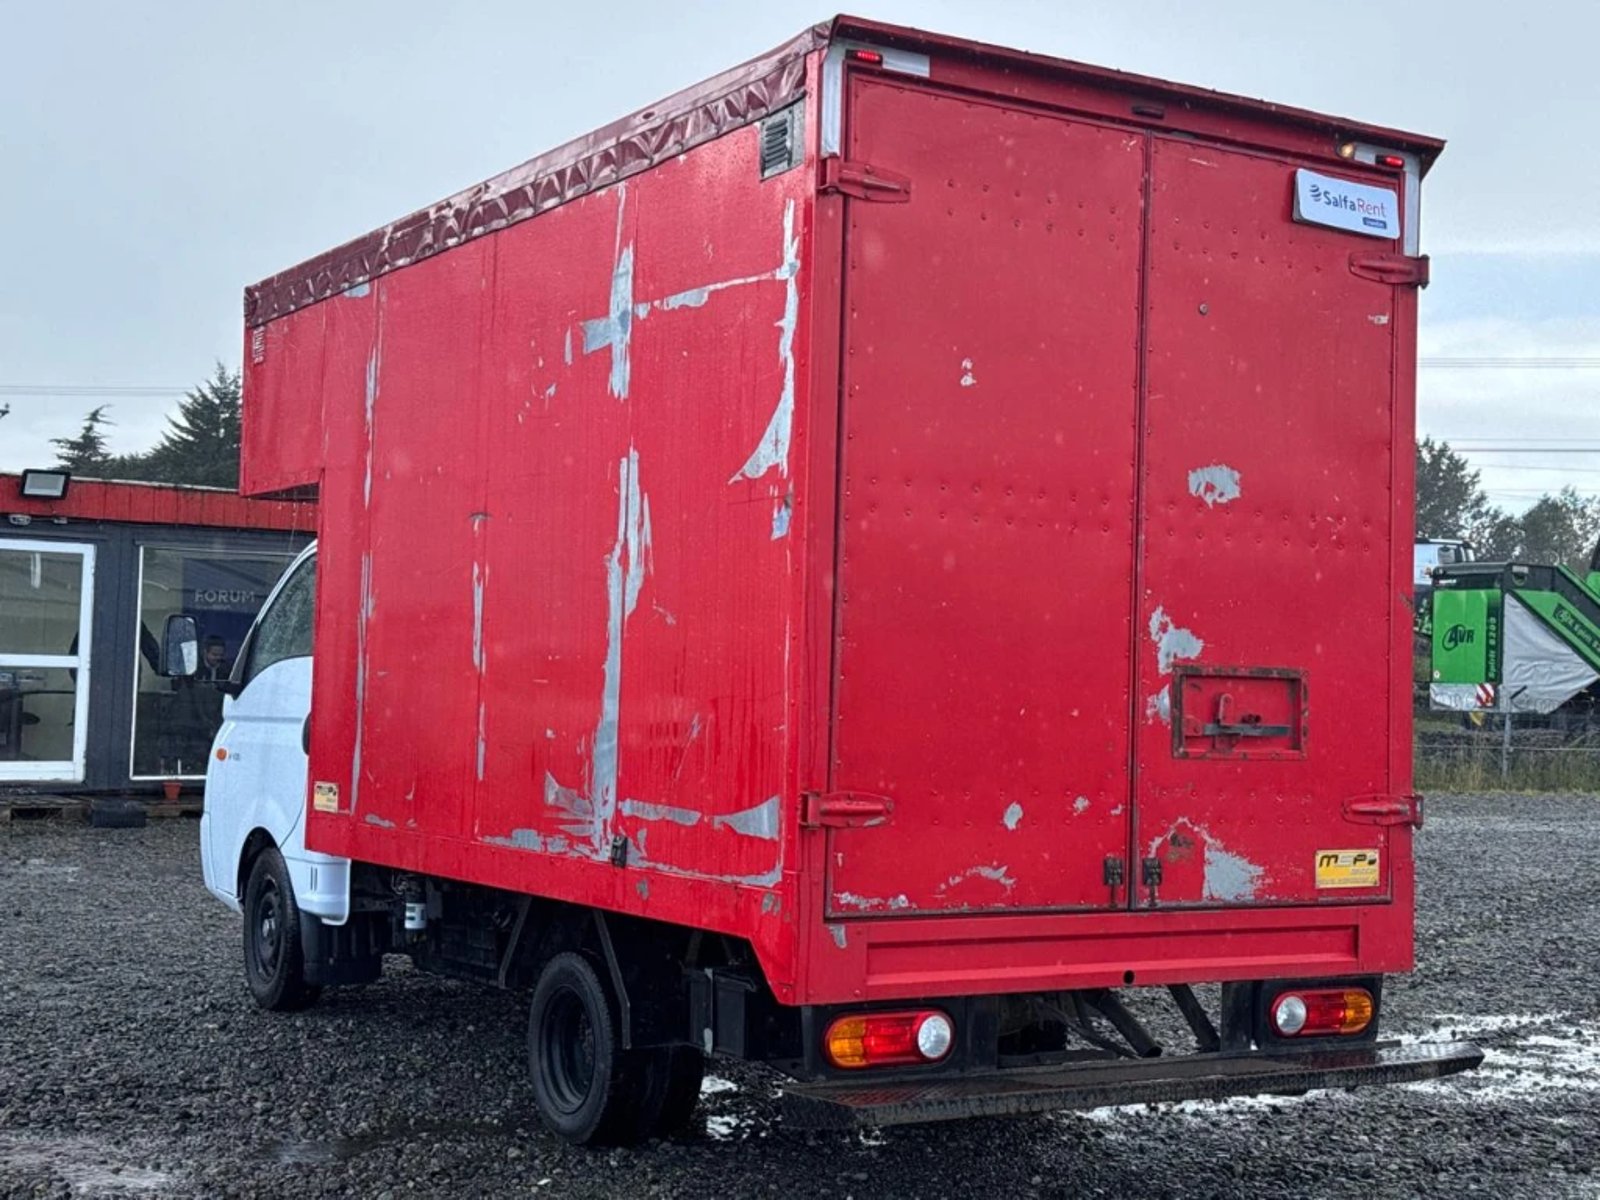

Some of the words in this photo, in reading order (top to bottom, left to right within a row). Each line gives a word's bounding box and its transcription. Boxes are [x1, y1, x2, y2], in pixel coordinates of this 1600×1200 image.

[1323, 191, 1387, 217] SalfaRent
[194, 589, 255, 603] FORUM
[1445, 624, 1475, 647] AVR
